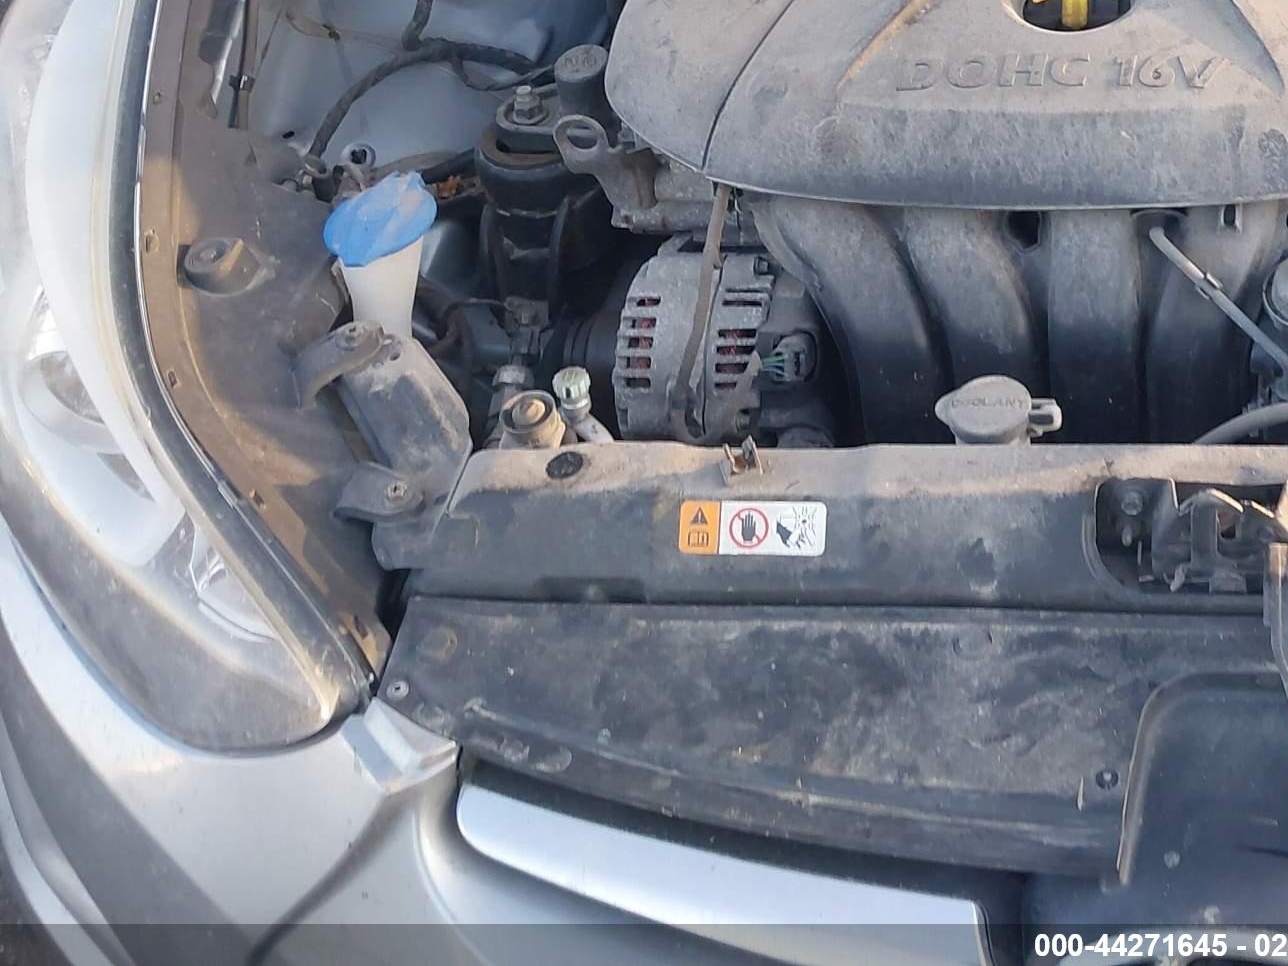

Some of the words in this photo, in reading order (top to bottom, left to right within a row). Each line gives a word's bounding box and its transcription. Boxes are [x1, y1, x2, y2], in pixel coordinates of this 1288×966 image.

[896, 52, 1090, 92] DOHC
[1113, 52, 1229, 91] 16V
[952, 396, 1025, 411] COOLANT
